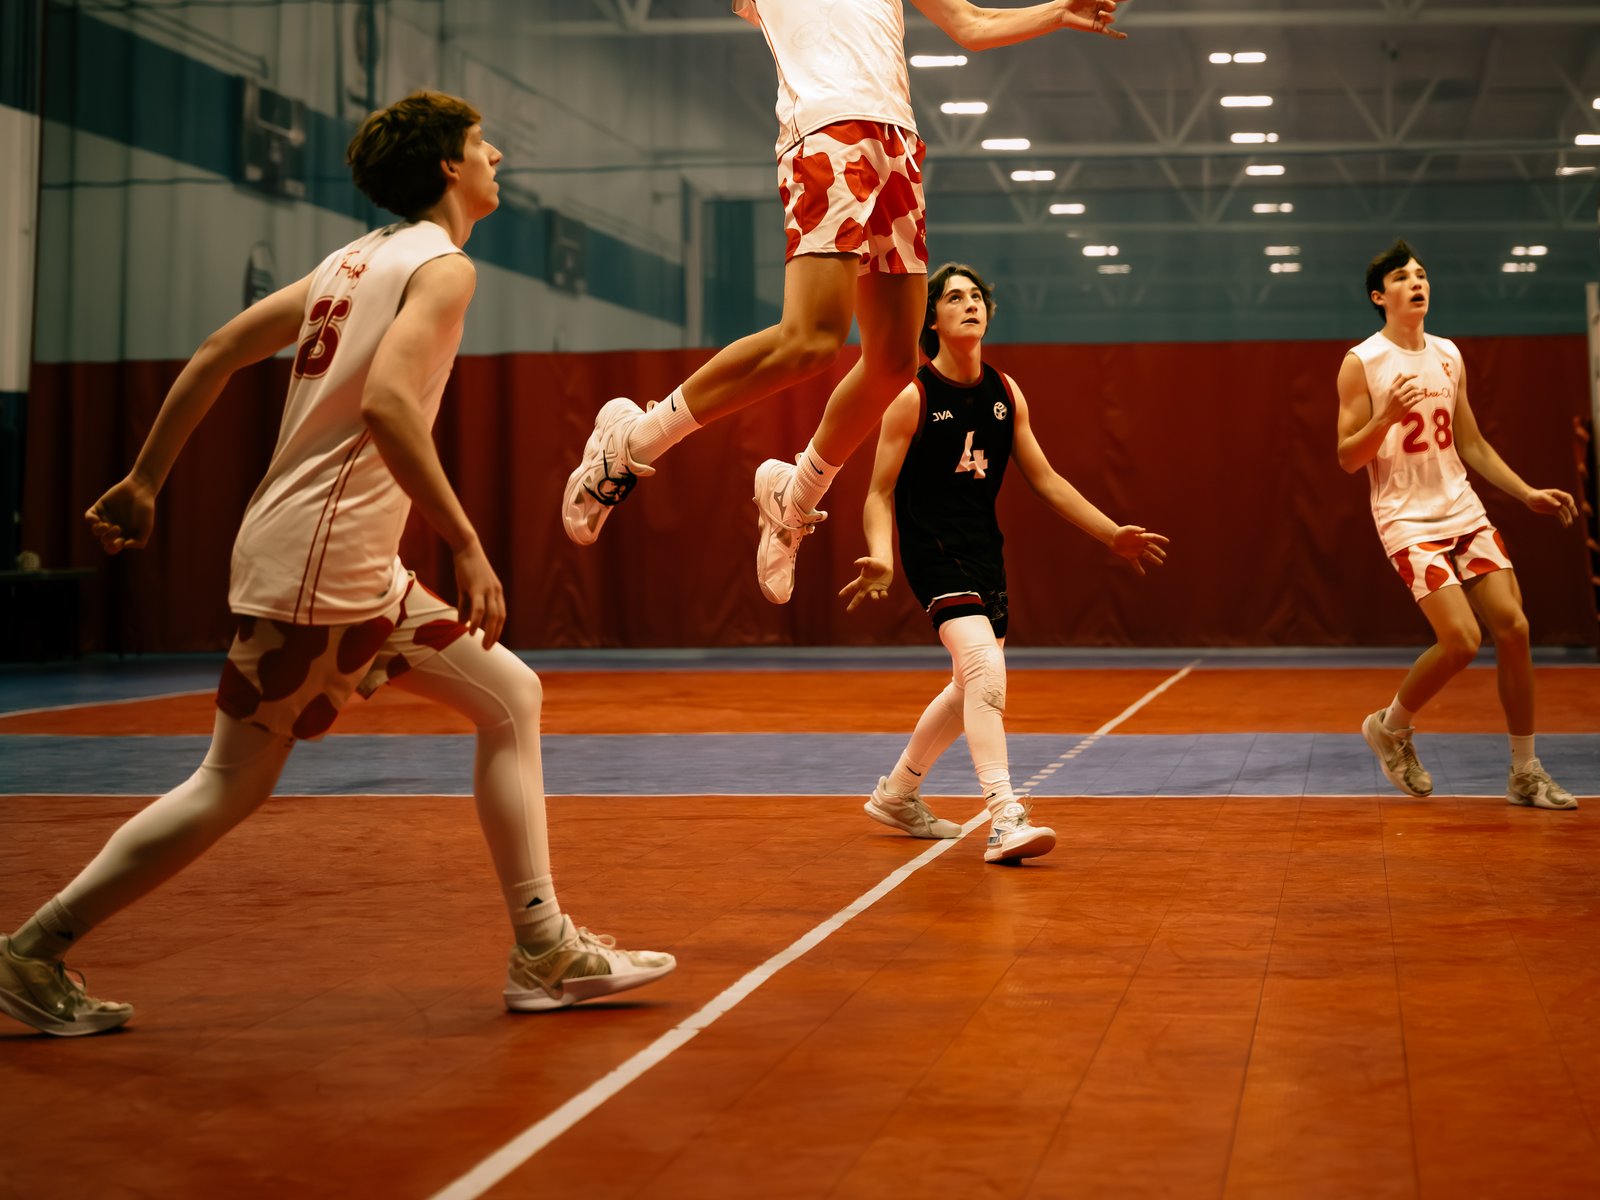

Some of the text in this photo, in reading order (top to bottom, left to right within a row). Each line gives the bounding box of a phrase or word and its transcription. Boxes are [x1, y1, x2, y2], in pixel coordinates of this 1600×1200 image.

[932, 410, 954, 422] JVA
[1401, 408, 1453, 454] 28
[954, 430, 988, 479] 4
